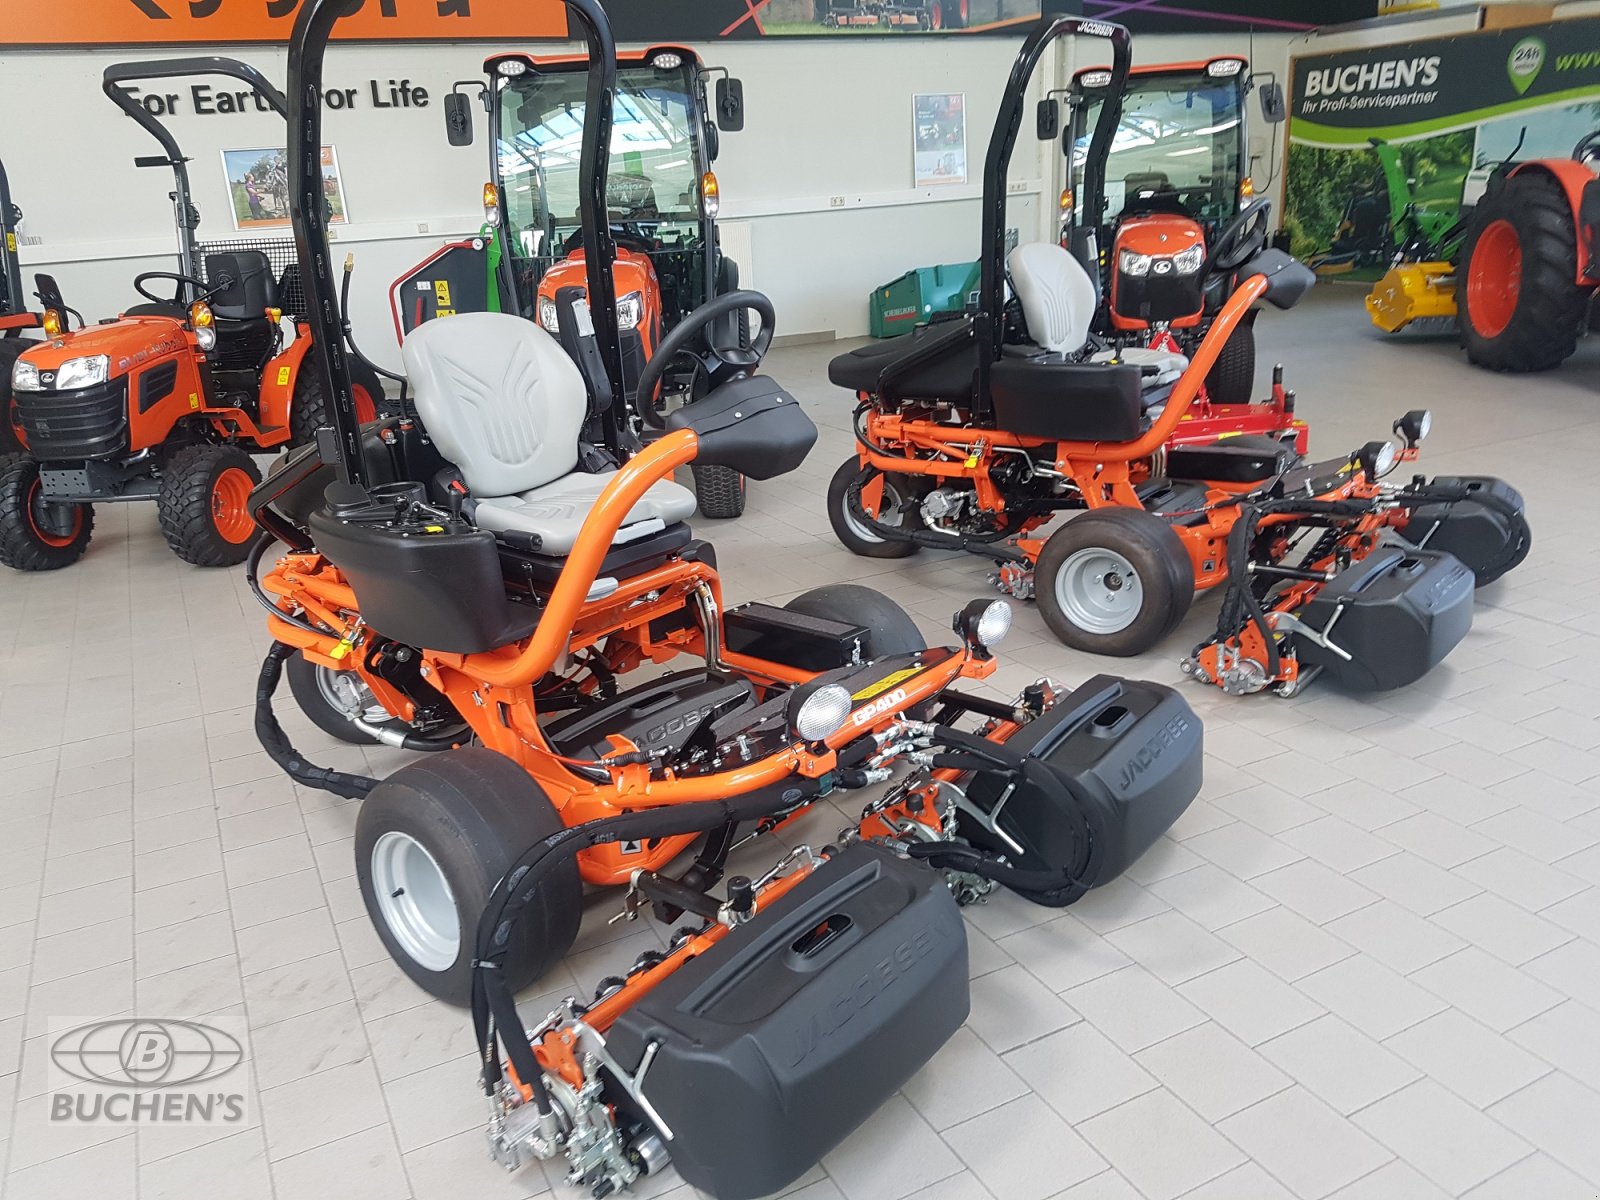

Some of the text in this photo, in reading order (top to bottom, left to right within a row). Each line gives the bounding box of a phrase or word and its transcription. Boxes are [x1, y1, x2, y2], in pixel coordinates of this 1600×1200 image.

[321, 88, 357, 110] or
[369, 79, 429, 108] Life
[1304, 56, 1441, 97] BUCHEN'S
[1302, 90, 1439, 114] Ihr Profi-Servicepartner
[852, 688, 907, 726] GP400
[1120, 711, 1190, 791] JACOBSE
